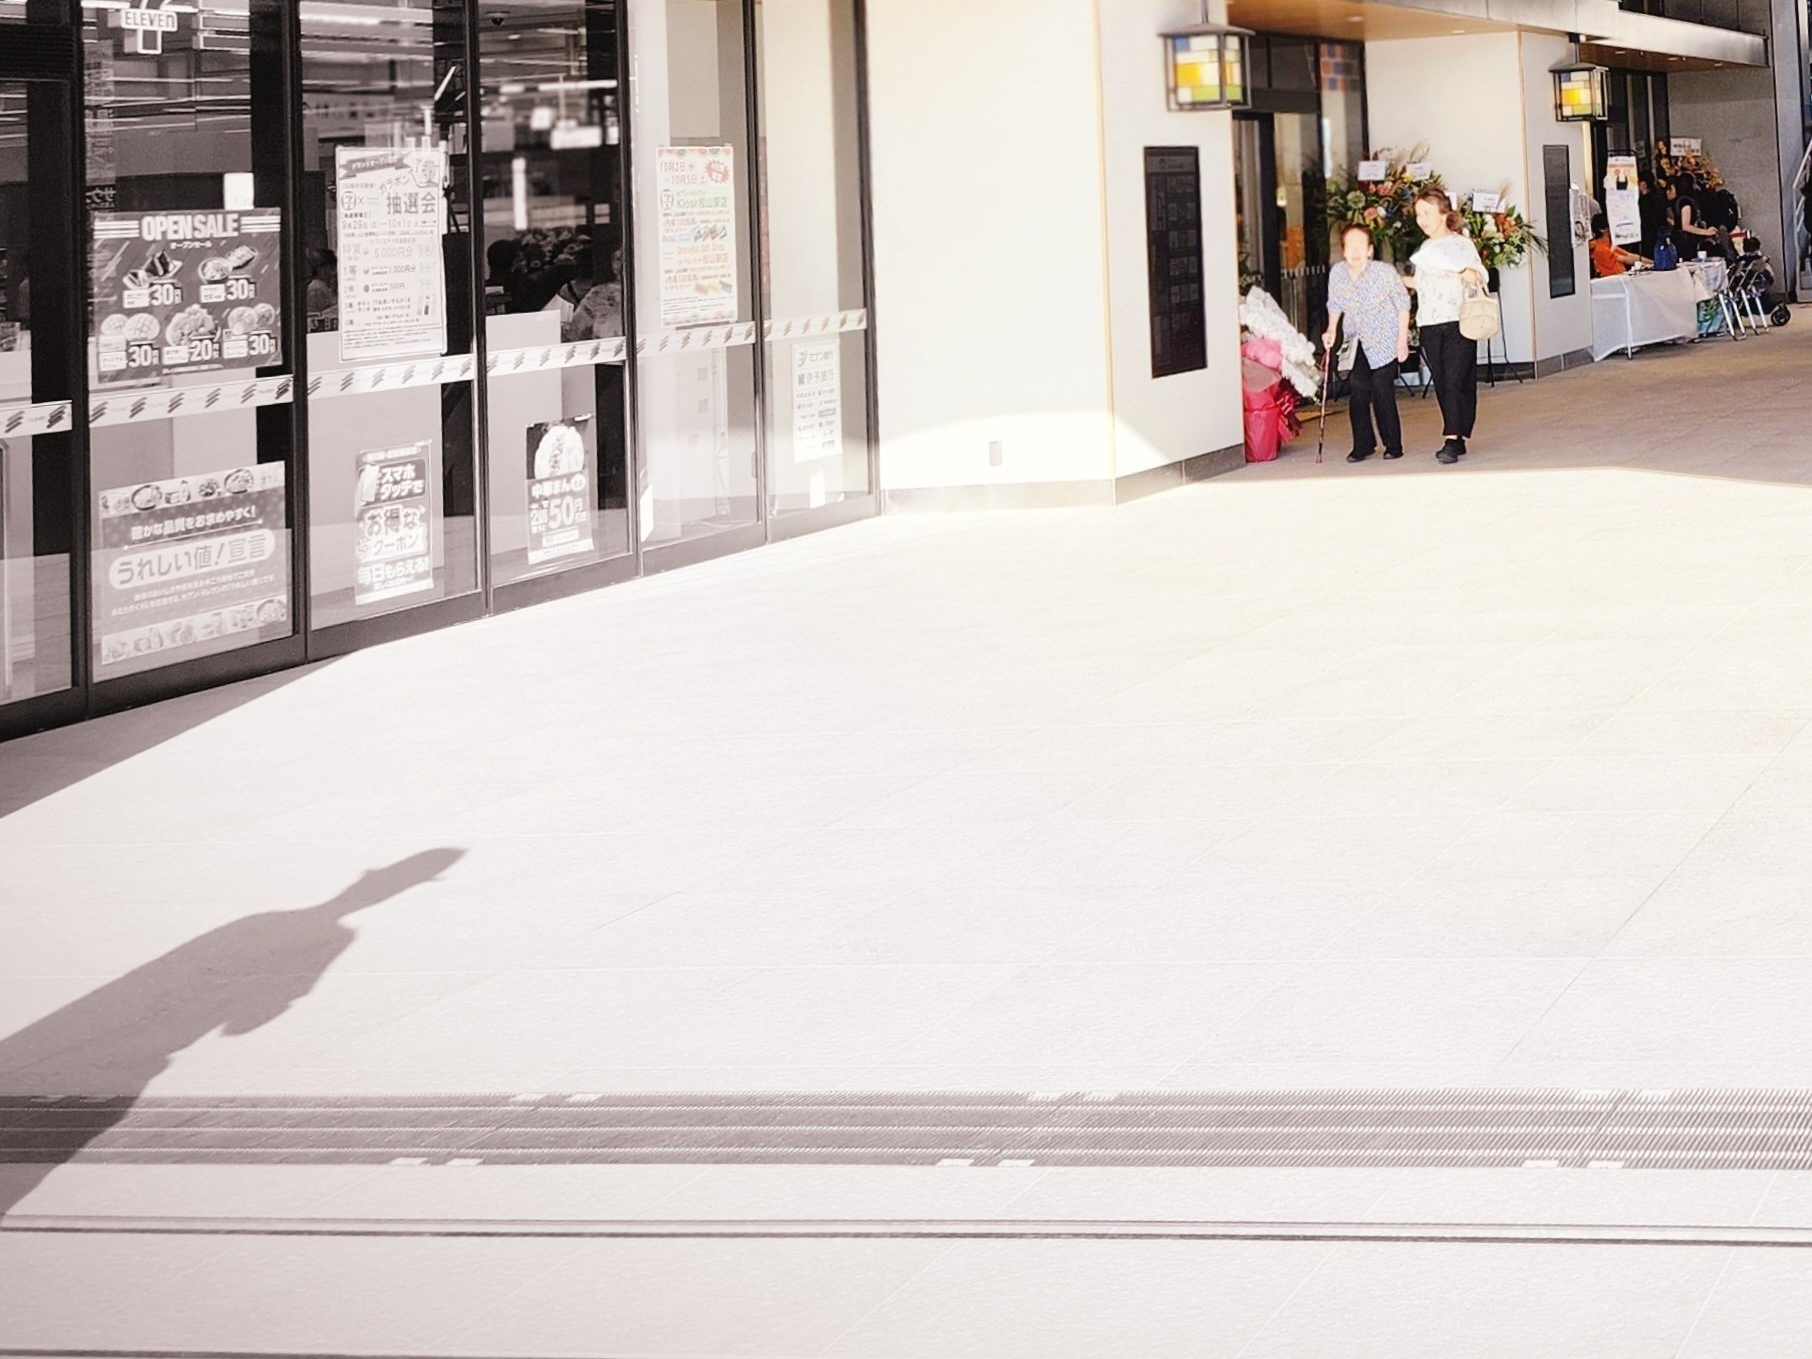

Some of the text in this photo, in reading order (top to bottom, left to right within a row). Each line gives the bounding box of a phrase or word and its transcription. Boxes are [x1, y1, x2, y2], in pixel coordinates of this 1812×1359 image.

[386, 191, 435, 215] 抽選会
[141, 213, 239, 241] OPEN SALE
[169, 240, 213, 250] オープンセール
[381, 463, 416, 484] スマホ
[380, 479, 424, 500] タッチで
[531, 479, 571, 499] 中華まん
[366, 507, 418, 537] お得な
[373, 534, 419, 556] クーポン
